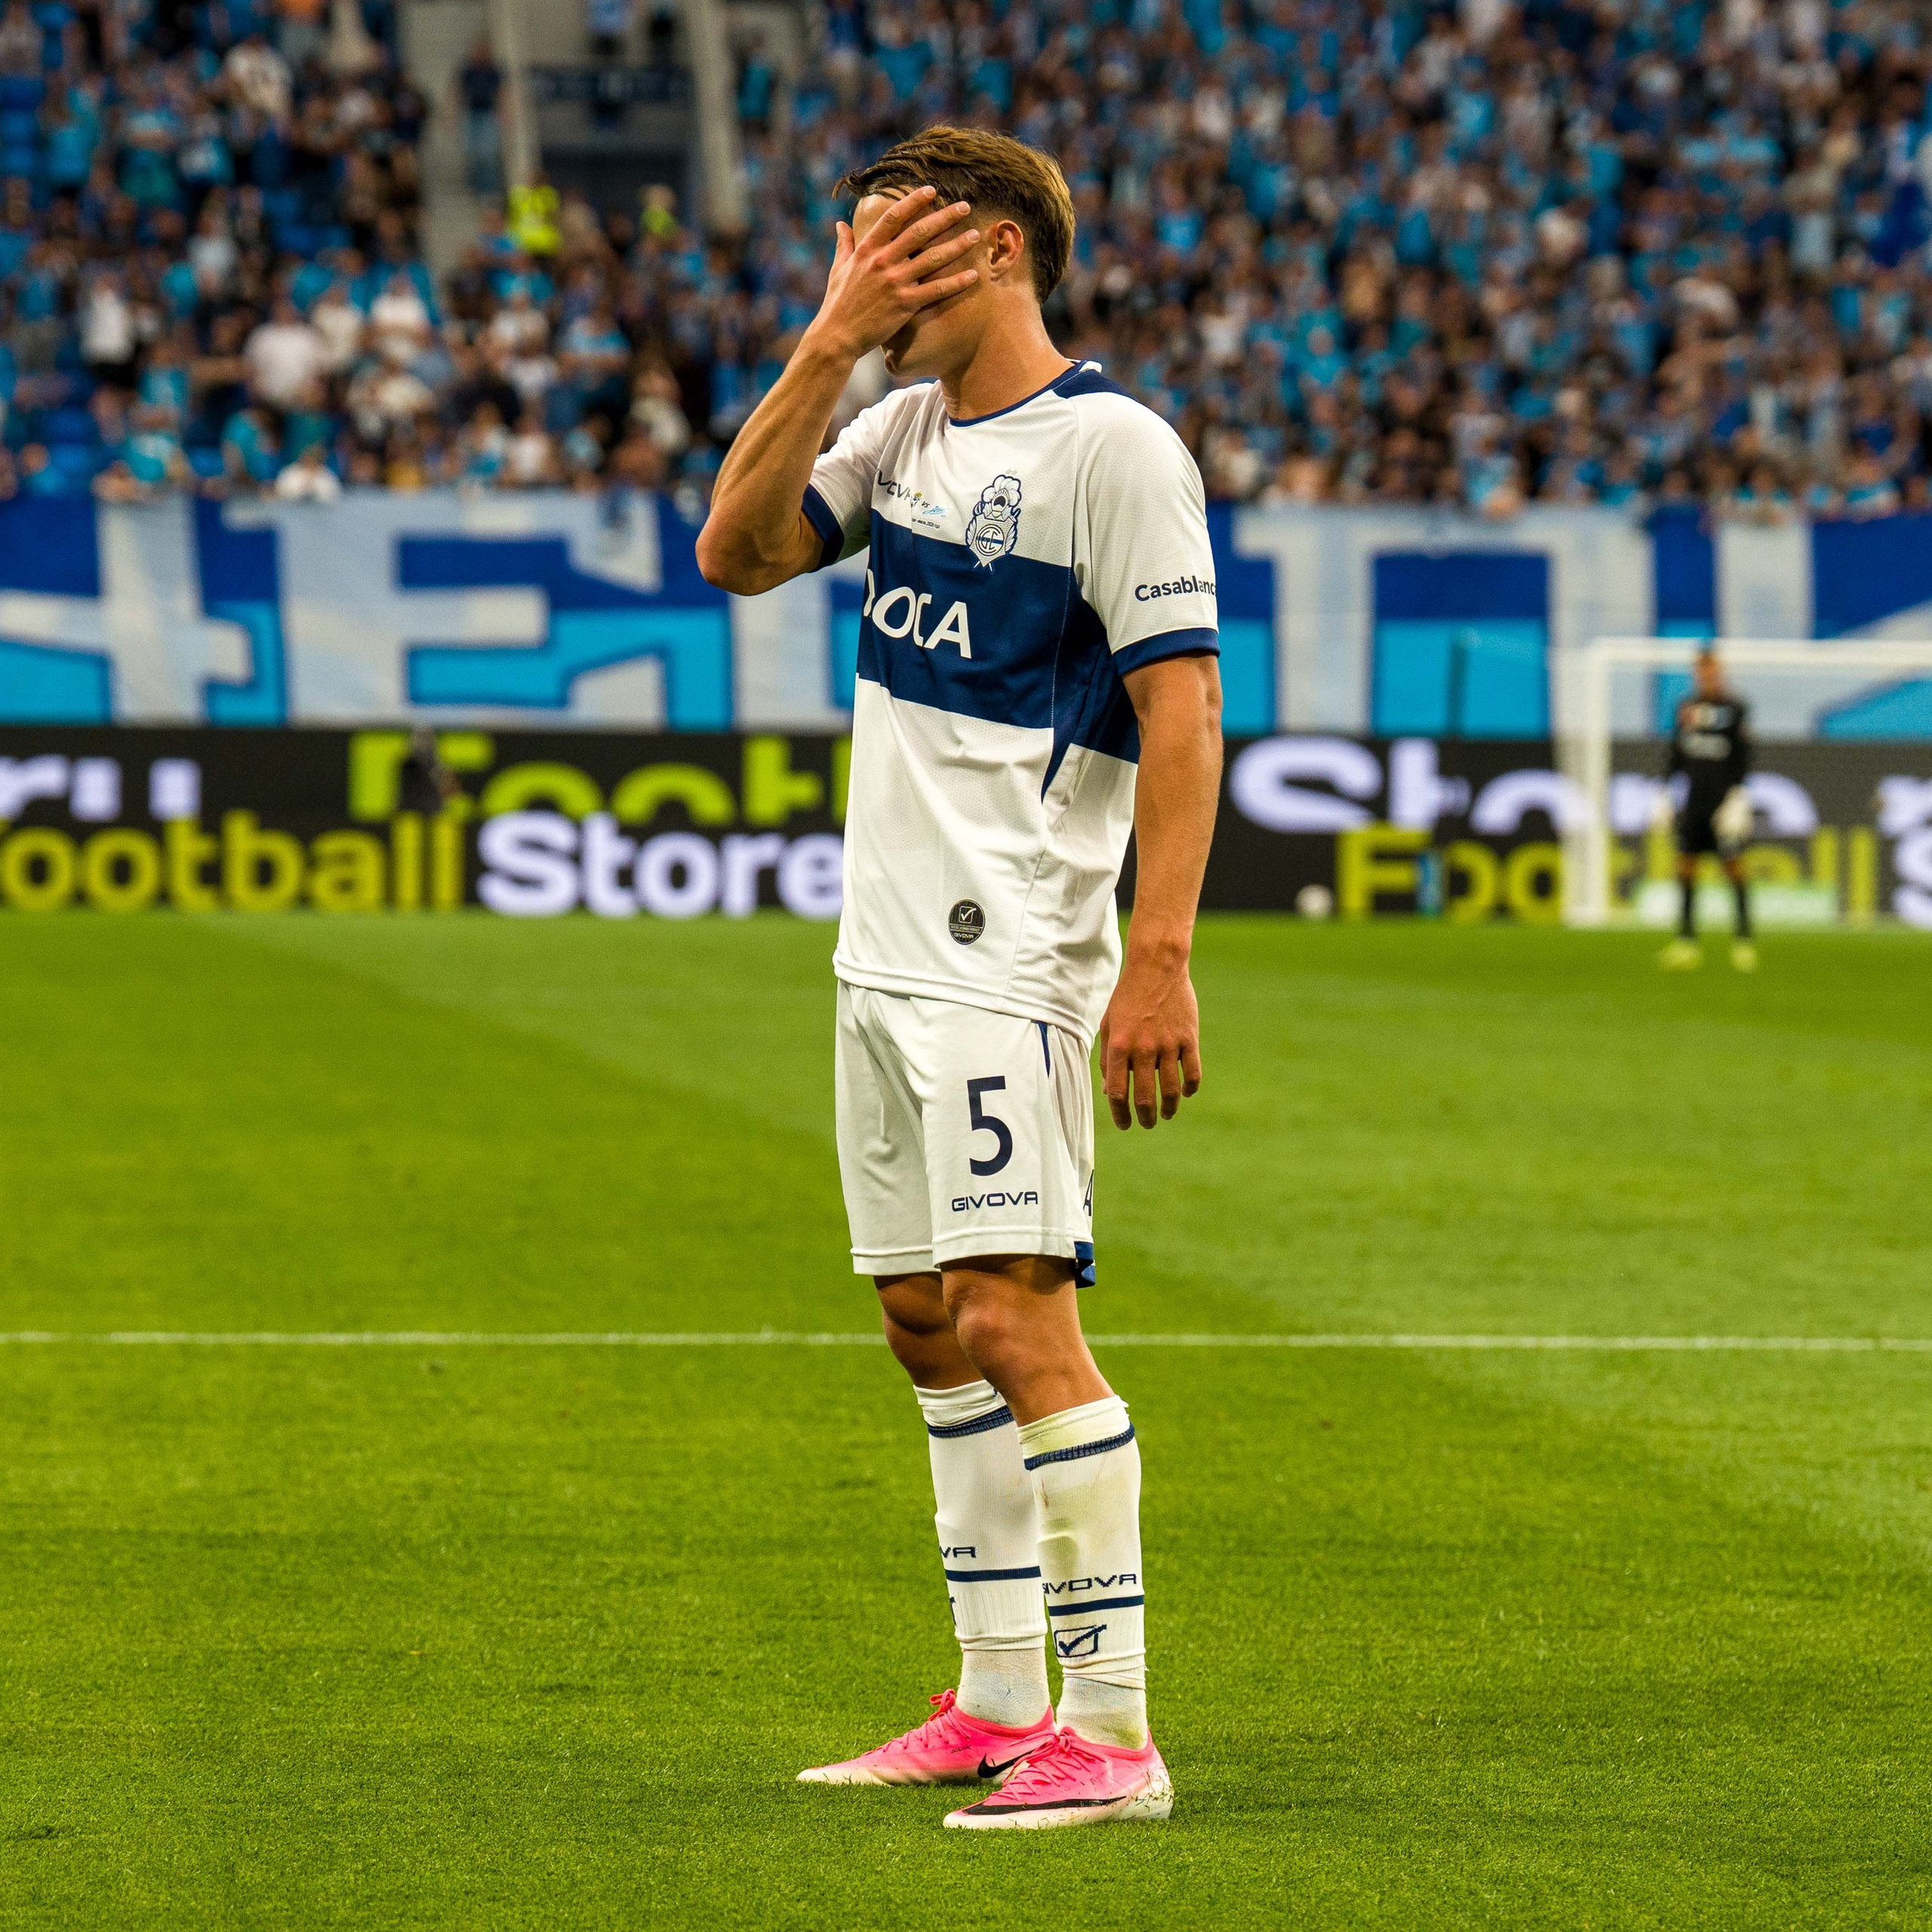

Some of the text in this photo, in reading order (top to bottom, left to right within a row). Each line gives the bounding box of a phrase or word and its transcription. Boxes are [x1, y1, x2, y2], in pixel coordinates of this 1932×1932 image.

[0, 809, 844, 919] ootball Store
[967, 1075, 1013, 1177] 5
[952, 1191, 1038, 1212] GIVOVA
